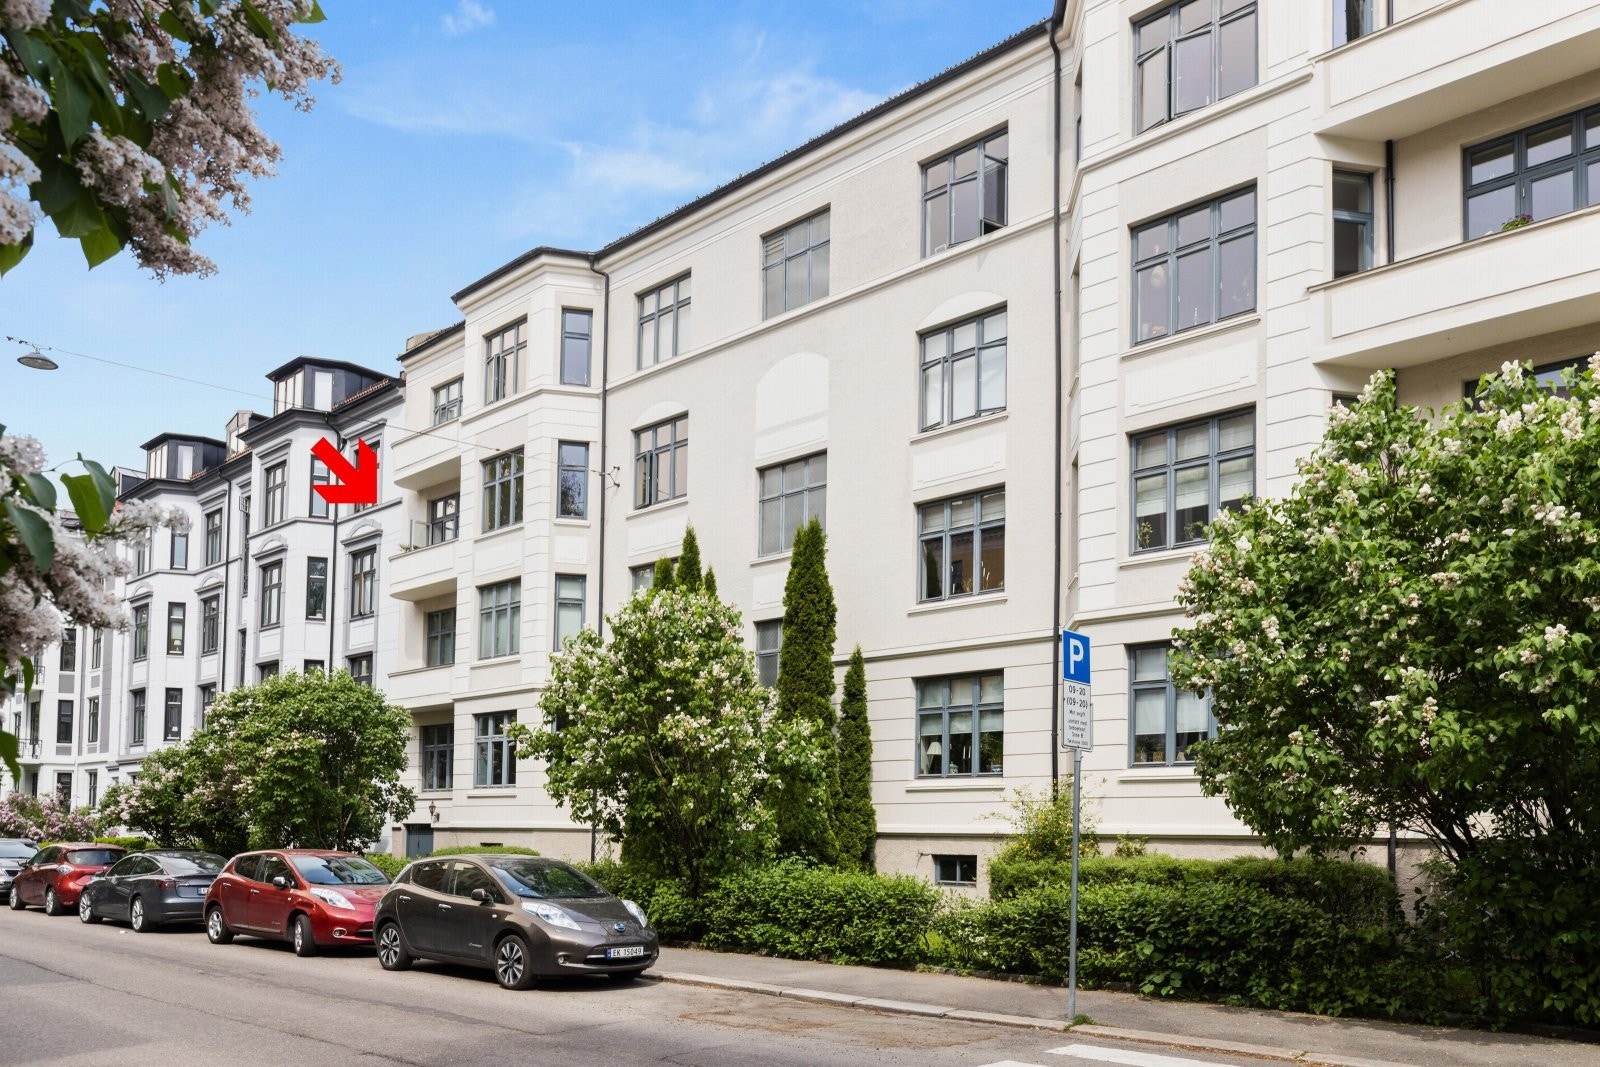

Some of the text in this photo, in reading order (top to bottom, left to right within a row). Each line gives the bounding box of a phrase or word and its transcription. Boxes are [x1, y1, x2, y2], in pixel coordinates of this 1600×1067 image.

[1070, 637, 1084, 675] P
[1068, 685, 1086, 696] 09-20
[1066, 696, 1088, 709] (09-20)
[612, 947, 642, 957] EK 15049
